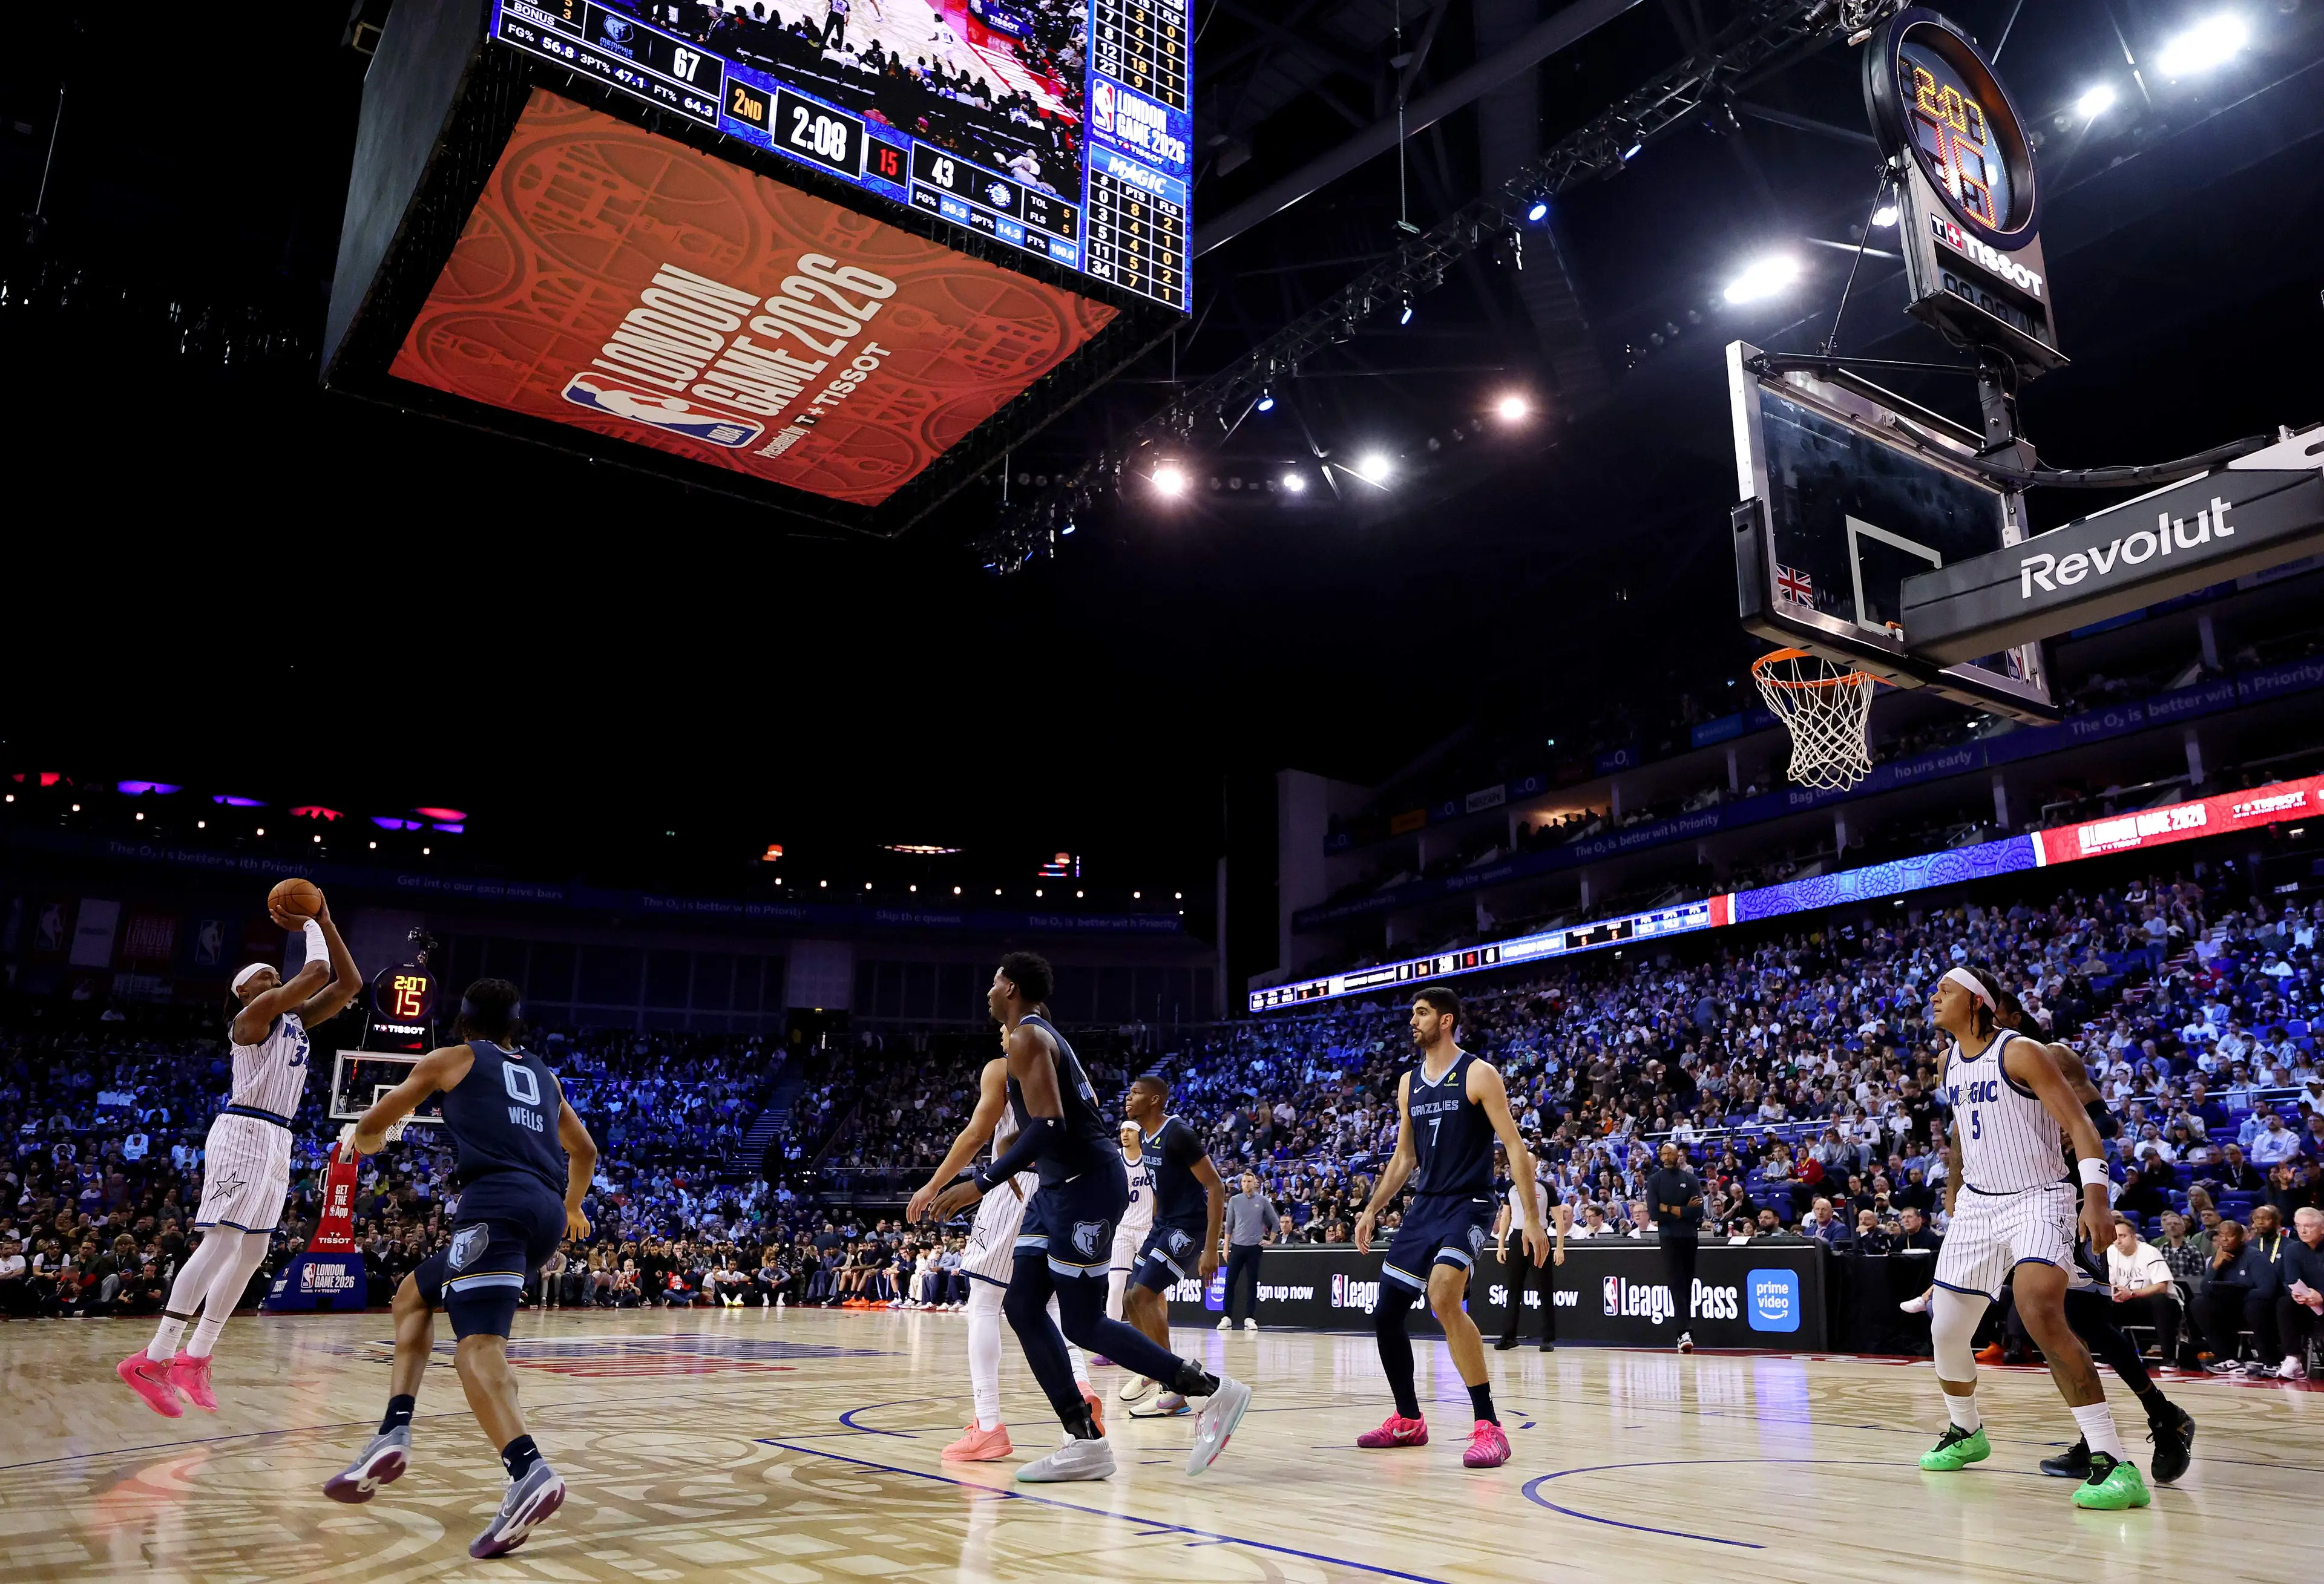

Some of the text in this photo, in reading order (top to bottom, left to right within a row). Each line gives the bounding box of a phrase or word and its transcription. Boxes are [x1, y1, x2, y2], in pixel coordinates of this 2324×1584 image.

[514, 2, 555, 26] BONUS
[563, 8, 571, 19] 3
[989, 15, 1019, 31] TISSOT
[1105, 9, 1175, 38] 7 3 0
[1163, 10, 1180, 24] FLS
[600, 36, 633, 56] MEMPHIS
[1105, 27, 1175, 54] 8 4 0
[673, 47, 700, 82] 67
[1101, 42, 1173, 70] 12 7 1
[508, 24, 713, 117] FG% 56.8 3PT% 47.1 FT% 64.3
[1099, 58, 1173, 87] 23 18 1
[1134, 76, 1173, 103] 9 1
[734, 88, 762, 121] 2ND
[1117, 90, 1167, 133] LONDON
[1914, 67, 1987, 146] 2:07
[790, 106, 847, 162] 2:08
[1116, 113, 1151, 149] GAME
[1152, 129, 1185, 165] 2026
[880, 149, 898, 175] 15
[1130, 146, 1163, 165] TISSOT
[931, 157, 954, 188] 43
[1108, 157, 1167, 194] MAGIC
[1937, 122, 1996, 229] 15
[1031, 196, 1070, 218] TOL 5
[1099, 190, 1172, 231] 0 8 2
[1126, 186, 1146, 201] PTS
[1160, 201, 1177, 215] FLS
[916, 191, 936, 207] FG%
[971, 212, 994, 229] 3PT%
[997, 223, 1021, 240] 14.3
[1027, 234, 1046, 249] FT%
[1050, 243, 1075, 260] 100.0
[1030, 212, 1069, 234] FLS 5
[1098, 208, 1170, 247] 3 4 1
[1098, 225, 1172, 265] 5 4 0
[1094, 243, 1172, 283] 11 5 2
[1960, 231, 2043, 296] TISSOT
[1092, 260, 1169, 300] 34 7 1
[591, 263, 761, 392] LONDON
[691, 253, 897, 416] GAME 2026
[753, 341, 891, 459] Presented T TISSOT
[2021, 496, 2234, 599] Revolut
[2070, 719, 2100, 736] The
[2129, 708, 2142, 721] is
[2148, 695, 2202, 716] better
[2253, 665, 2324, 691] Priority
[1790, 791, 1813, 804] Bag
[1894, 761, 1934, 778] hours
[1937, 750, 1972, 768] early
[1574, 845, 1592, 857] The
[1608, 839, 1617, 849] is
[1620, 830, 1649, 847] better
[1679, 813, 1719, 830] Priority
[110, 842, 138, 855] The
[178, 849, 223, 866] better
[454, 883, 473, 892] our
[537, 888, 563, 899] bars
[395, 975, 426, 992] 2:07
[396, 990, 421, 1016] 15
[388, 1025, 425, 1035] TISSOT
[502, 1061, 540, 1106] 0
[1949, 1080, 1997, 1108] MAGIC
[508, 1106, 543, 1133] WELLS
[1411, 1100, 1459, 1118] GRIZZLIES
[1429, 1118, 1442, 1147] 7
[1972, 1111, 1980, 1140] 5
[2098, 1163, 2109, 1175] 5
[335, 1185, 349, 1195] GET
[335, 1196, 347, 1205] THE
[335, 1206, 349, 1219] App
[315, 1275, 355, 1288] GAME 2026
[316, 1264, 346, 1276] LONDON
[2119, 1268, 2142, 1278] DIOR
[1177, 1276, 1202, 1302] Pass
[1256, 1281, 1314, 1302] ign up now
[1621, 1277, 1738, 1325] Leagu Pass
[1757, 1281, 1789, 1297] prime
[1758, 1294, 1789, 1309] video
